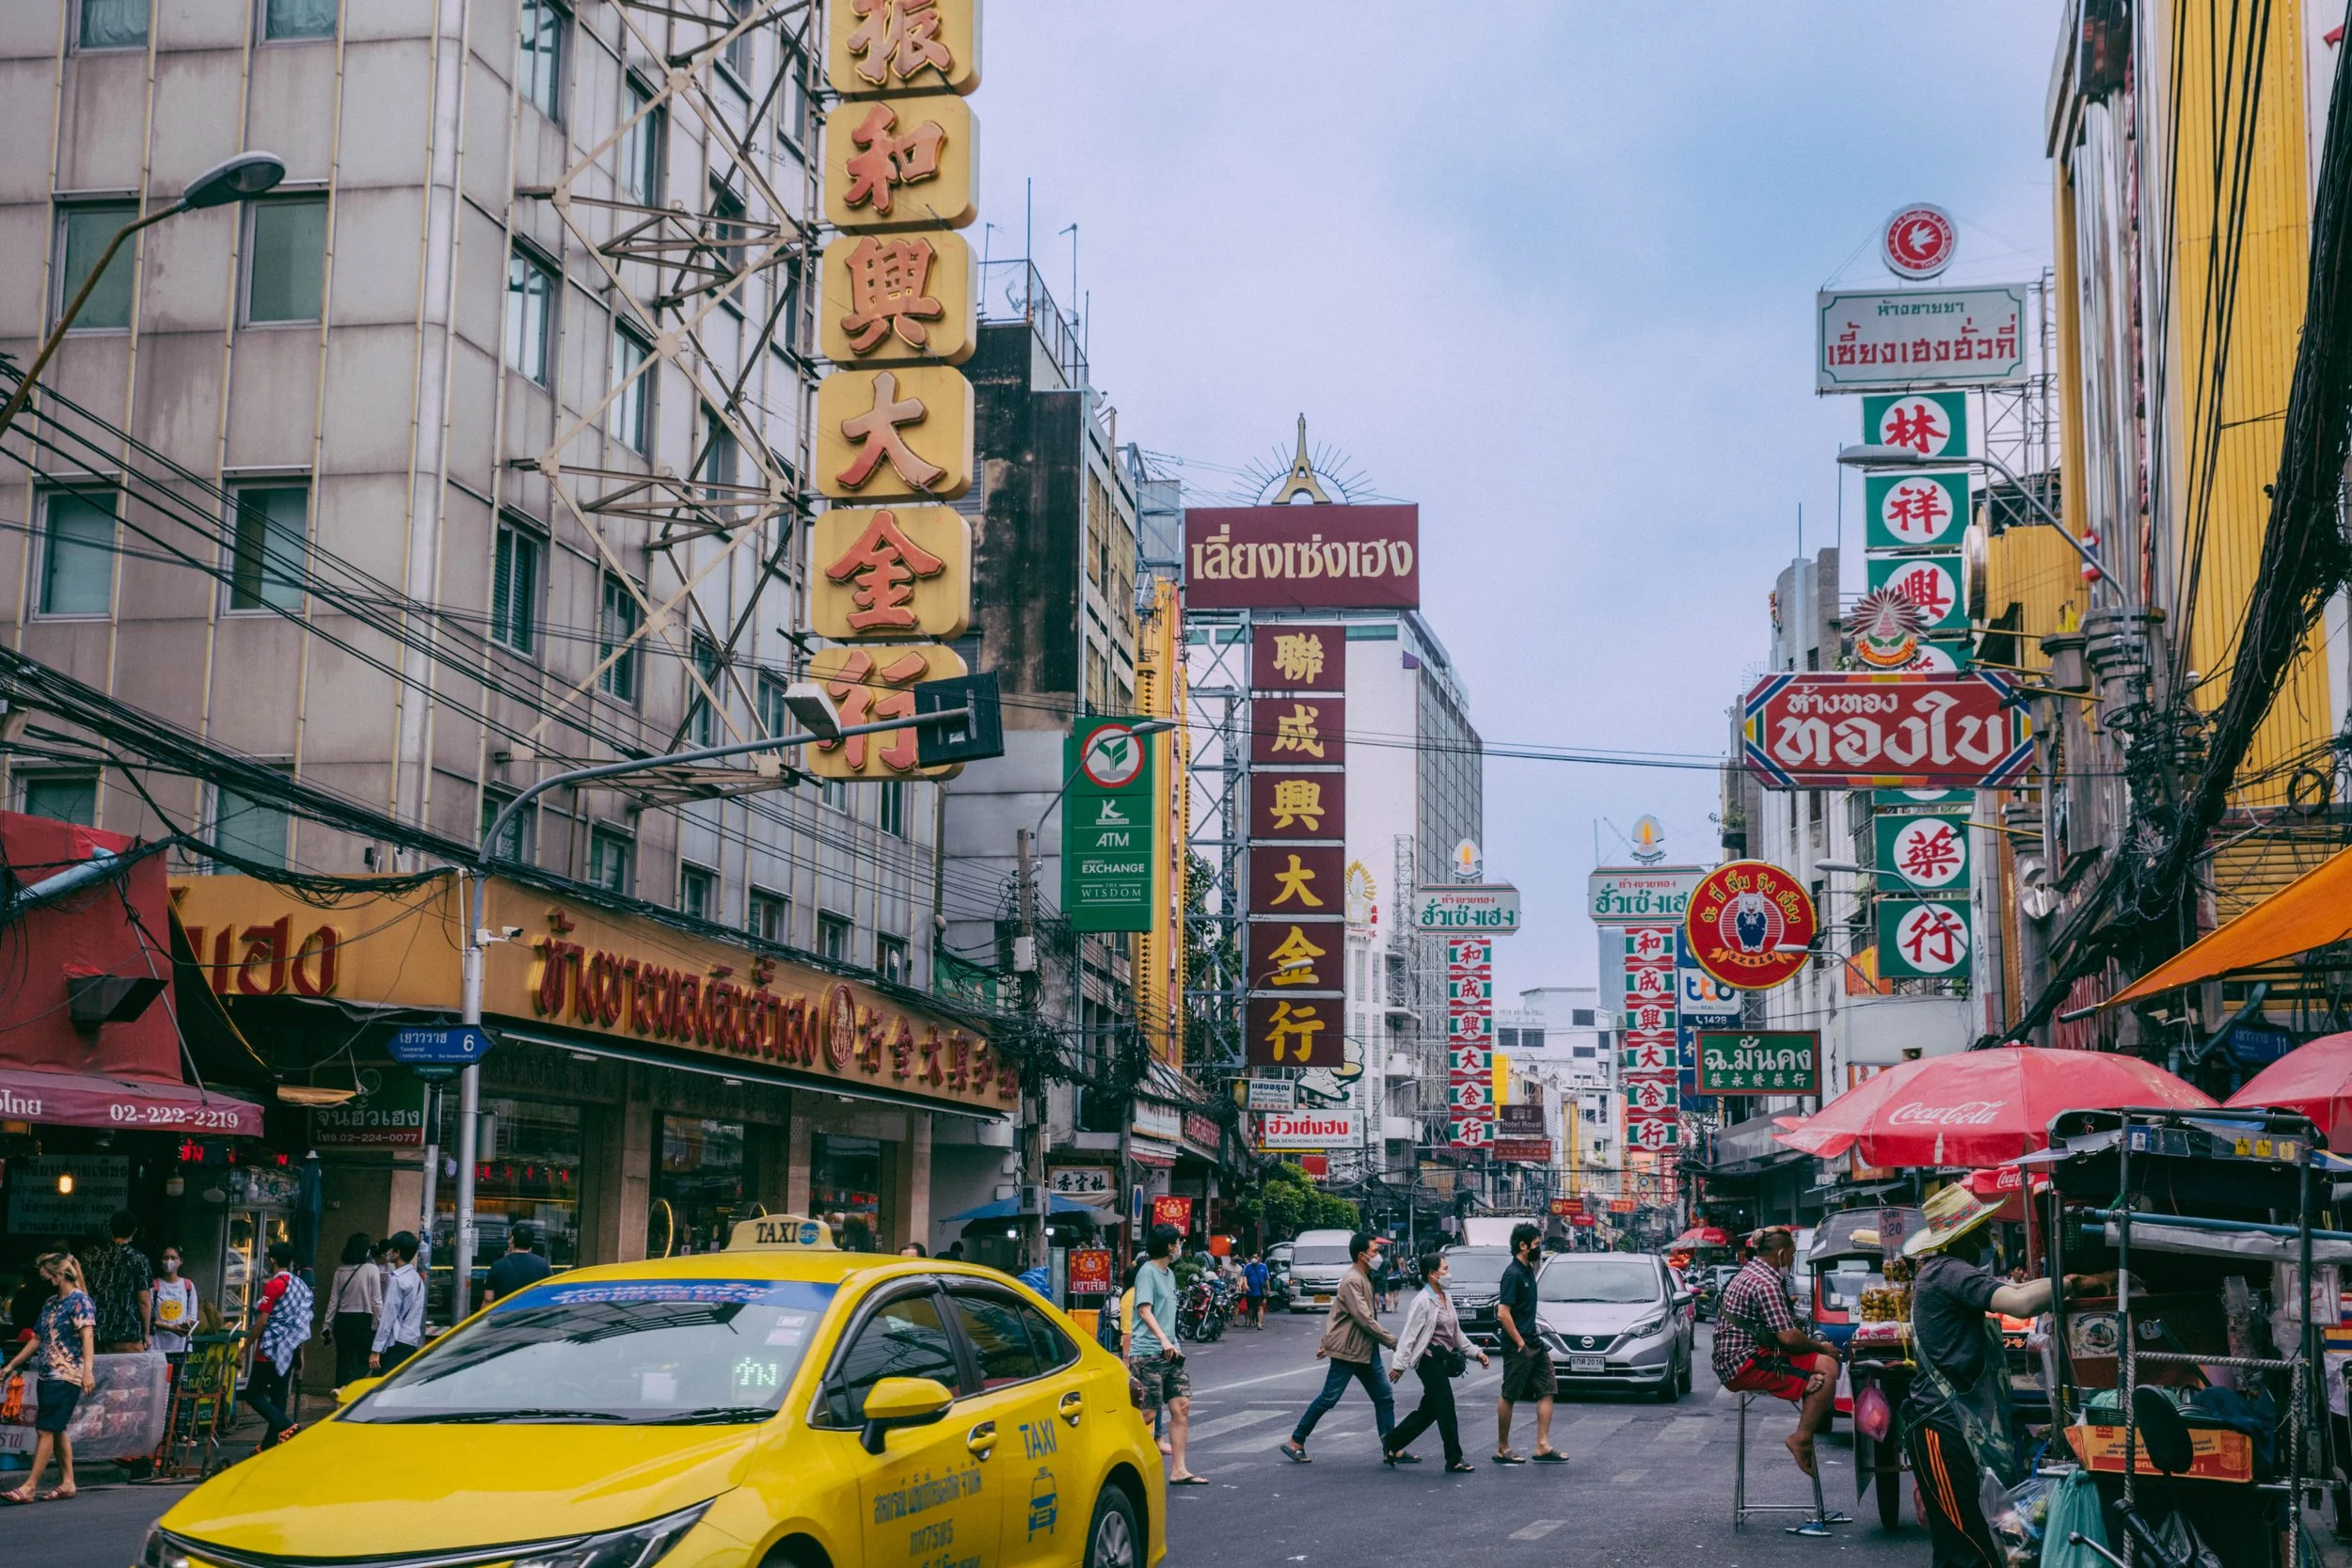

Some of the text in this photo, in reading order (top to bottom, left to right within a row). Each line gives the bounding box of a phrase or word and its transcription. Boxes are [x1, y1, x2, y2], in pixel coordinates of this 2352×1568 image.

[1877, 299, 1964, 316] ห้างขายยา
[1191, 524, 1414, 579] เลี่ยงเซ่งเฮง
[1788, 686, 1898, 715] ห้างทอง
[1774, 690, 2004, 767] ทองใบ
[1096, 832, 1129, 847] ATM
[1264, 632, 1326, 1063] 聯成興大金行
[1082, 863, 1145, 874] EXCHANGE
[1082, 888, 1141, 897] WISDOM
[1596, 882, 1688, 914] ฮั่วเซ่งเฮ
[1422, 898, 1515, 927] ฮั่วเซ่งเฮง
[1704, 1015, 1727, 1025] 1428
[400, 1032, 474, 1053] เยาวราช 6
[1460, 943, 1483, 1143] 和成興大金行
[1637, 931, 1665, 1148] 和成興大金行
[1704, 1036, 1812, 1070] ฉ.มั่นคง
[2276, 1036, 2287, 1053] 11
[109, 1103, 239, 1129] 02-222-2219
[1521, 1120, 1542, 1129] Royal
[1889, 1101, 2010, 1126] Coca-Cola
[755, 1222, 799, 1243] TAXI
[736, 1357, 777, 1386] ว่าง
[1019, 1418, 1057, 1460] TAXI
